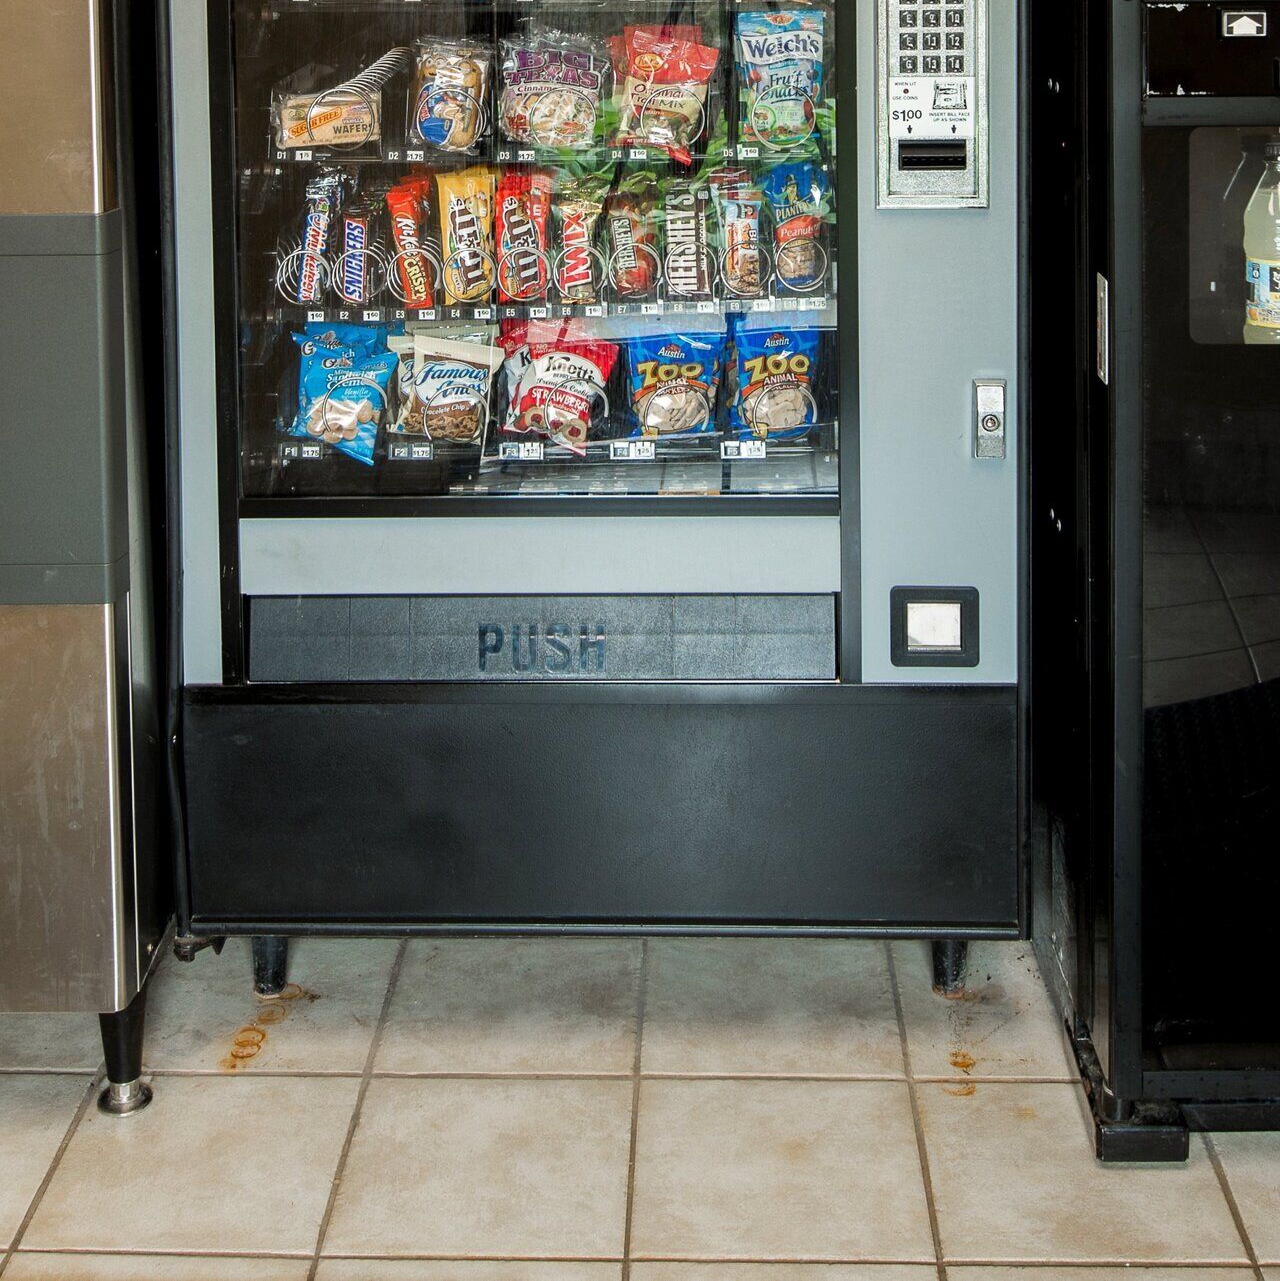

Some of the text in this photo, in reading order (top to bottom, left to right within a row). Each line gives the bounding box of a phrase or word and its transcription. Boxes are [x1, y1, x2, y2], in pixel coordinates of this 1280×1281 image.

[950, 35, 960, 46] 12
[745, 35, 820, 58] Welch's
[516, 49, 590, 71] BIG
[927, 58, 960, 69] 13 14
[505, 67, 598, 89] TEXAS
[770, 70, 803, 88] Fruit
[659, 99, 686, 109] Mix
[318, 110, 340, 124] FREE
[892, 109, 923, 122] $1.00
[277, 150, 287, 160] D1
[388, 151, 399, 160] D2
[500, 151, 510, 160] D3
[611, 150, 622, 159] D4
[723, 149, 734, 157] D5
[780, 225, 813, 238] Peanuts
[613, 218, 638, 270] HERSHEY'S
[665, 193, 698, 295] HERSHEY'S
[345, 220, 365, 301] SNICKERS
[403, 258, 428, 302] CRISPY
[617, 305, 627, 314] E7
[673, 303, 684, 311] E8
[730, 303, 740, 311] E9
[783, 301, 798, 309] E10
[396, 311, 405, 319] E3
[451, 308, 460, 318] E4
[506, 308, 516, 317] E5
[562, 307, 571, 316] E6
[763, 337, 790, 348] Austin
[657, 346, 686, 359] Austin
[545, 355, 595, 381] Knott's
[745, 354, 810, 385] ZOO
[414, 362, 488, 386] Famous
[637, 361, 704, 387] ZOO
[763, 373, 798, 385] ANIMAL
[451, 403, 466, 411] Chip
[284, 447, 295, 456] F1
[395, 447, 406, 456] F2
[617, 447, 628, 456] F4
[478, 622, 607, 672] PUSH
